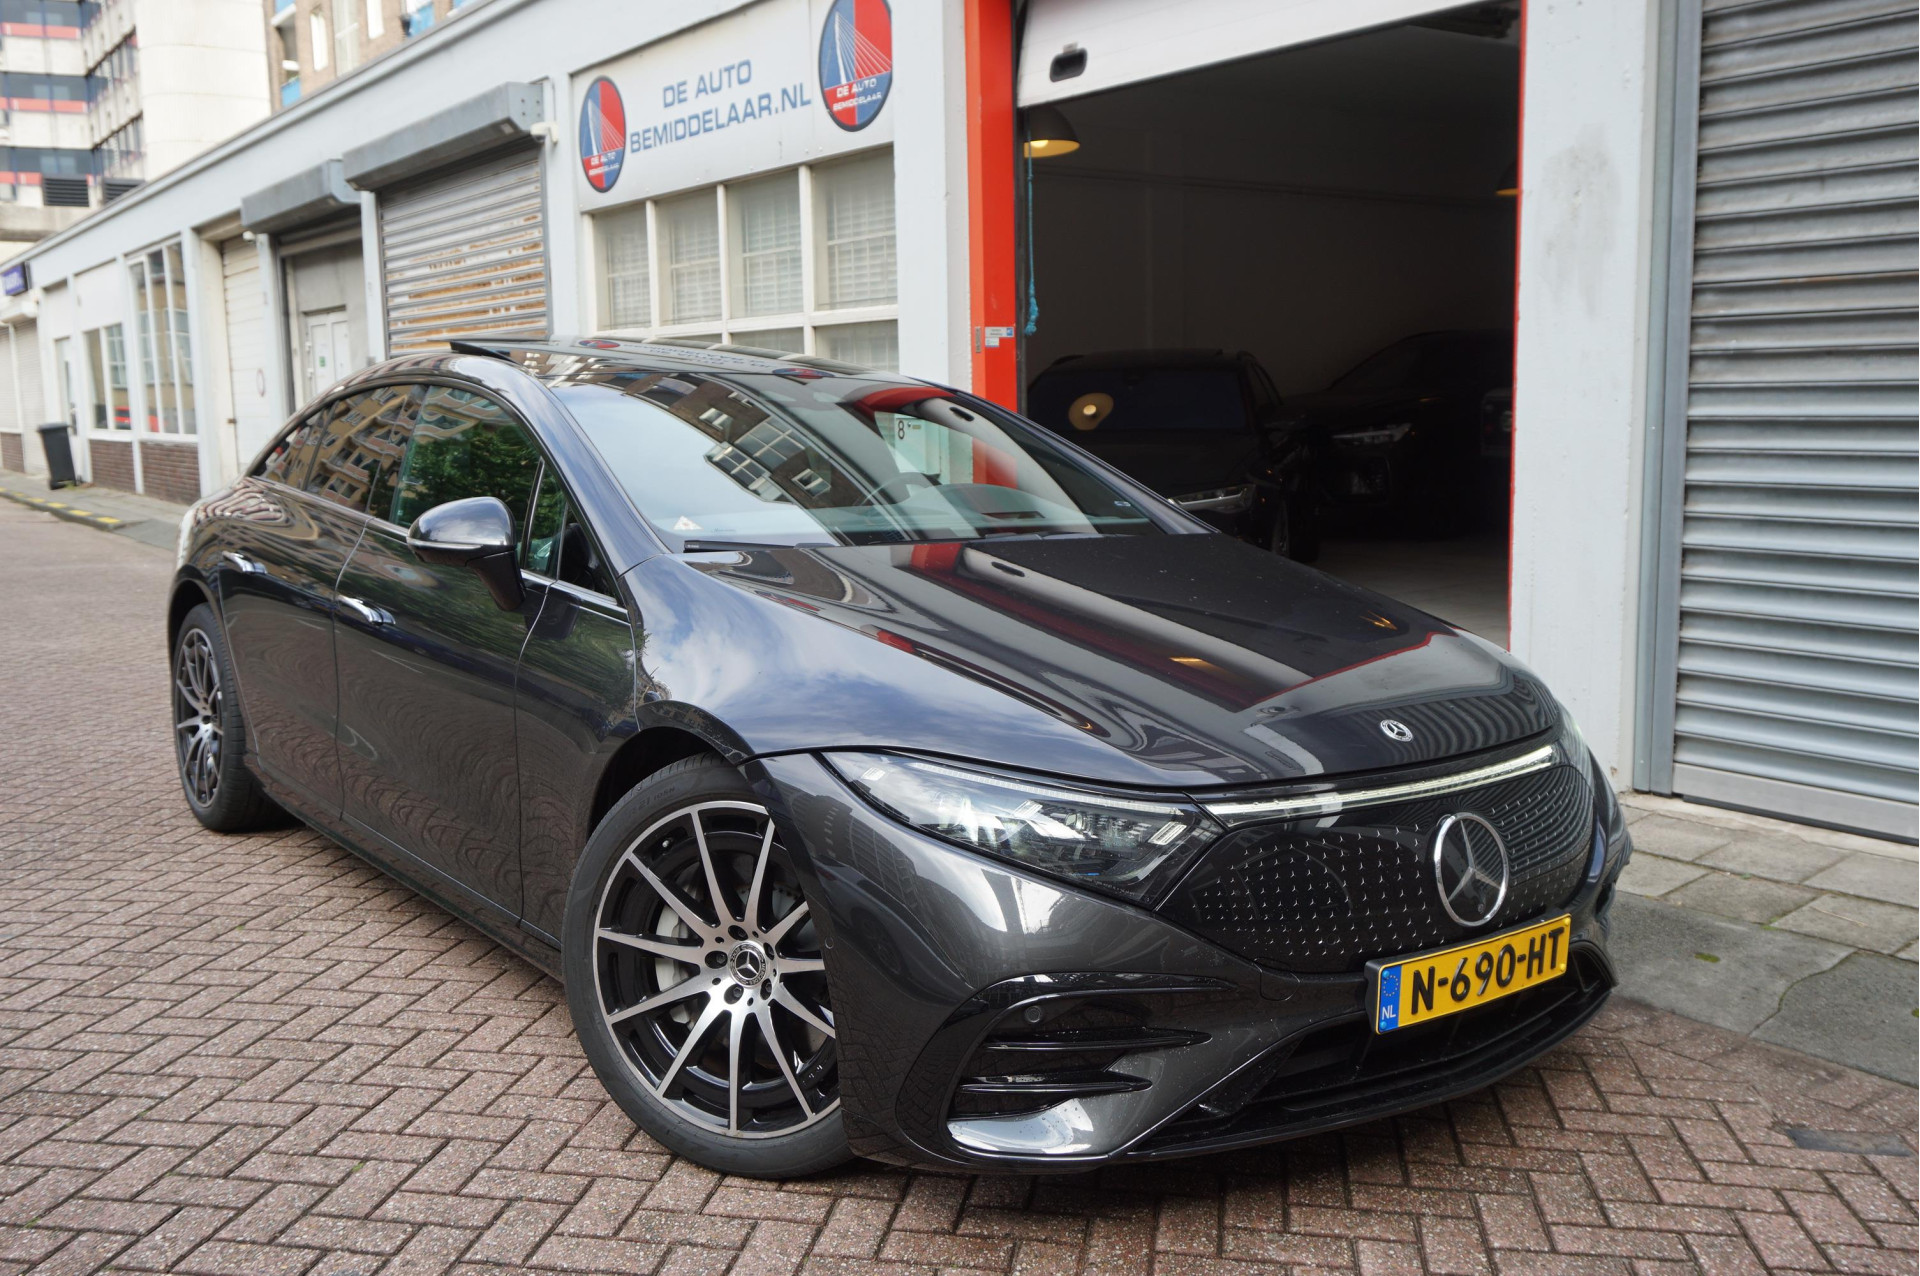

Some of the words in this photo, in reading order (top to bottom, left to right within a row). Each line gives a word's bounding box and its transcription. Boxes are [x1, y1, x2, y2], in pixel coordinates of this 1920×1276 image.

[663, 80, 688, 109] DE
[695, 59, 752, 99] AUTO
[836, 85, 849, 98] DE
[851, 78, 877, 94] AUTO
[630, 82, 811, 154] BEMIDDELAAR.NL
[898, 420, 905, 440] 8
[1411, 927, 1564, 1015] N-690-HT
[1382, 1004, 1396, 1020] NL
